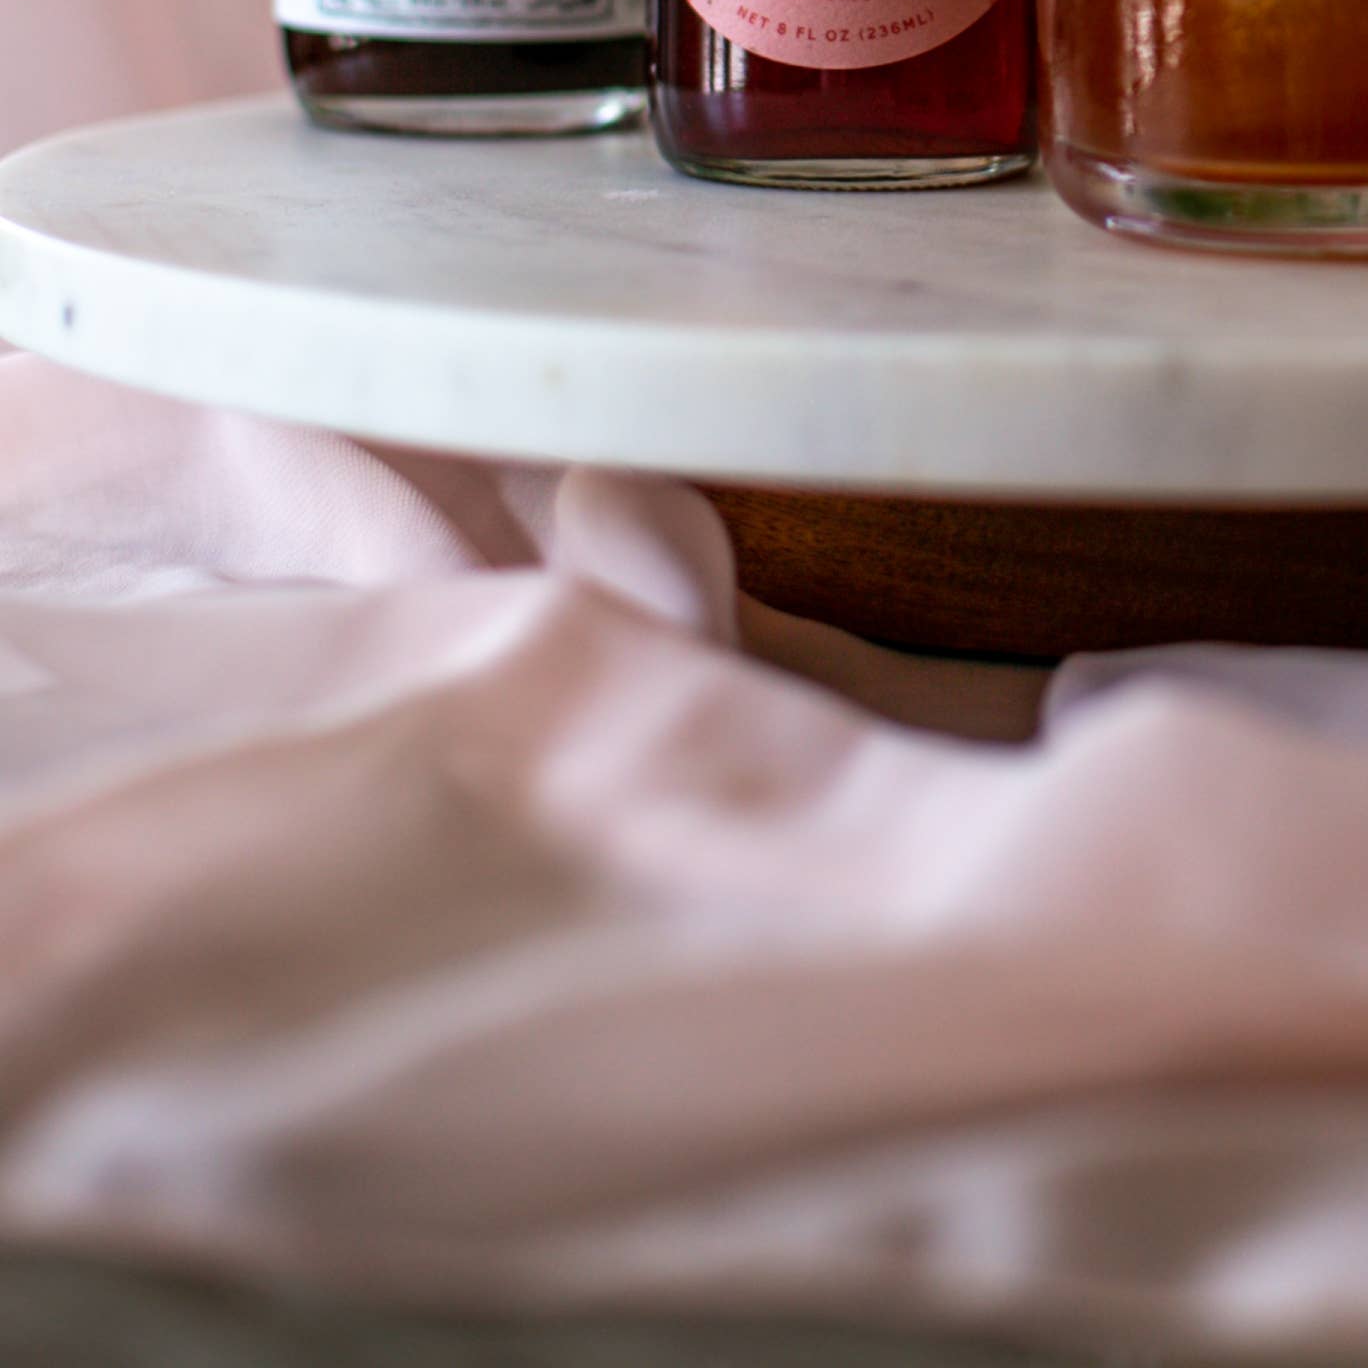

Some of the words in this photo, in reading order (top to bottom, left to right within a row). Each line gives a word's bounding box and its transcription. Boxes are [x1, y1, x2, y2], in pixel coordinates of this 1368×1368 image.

[737, 5, 770, 28] NET
[777, 22, 787, 36] 8
[796, 26, 816, 41] FL
[825, 29, 850, 42] OZ
[859, 8, 935, 41] (236ML)
